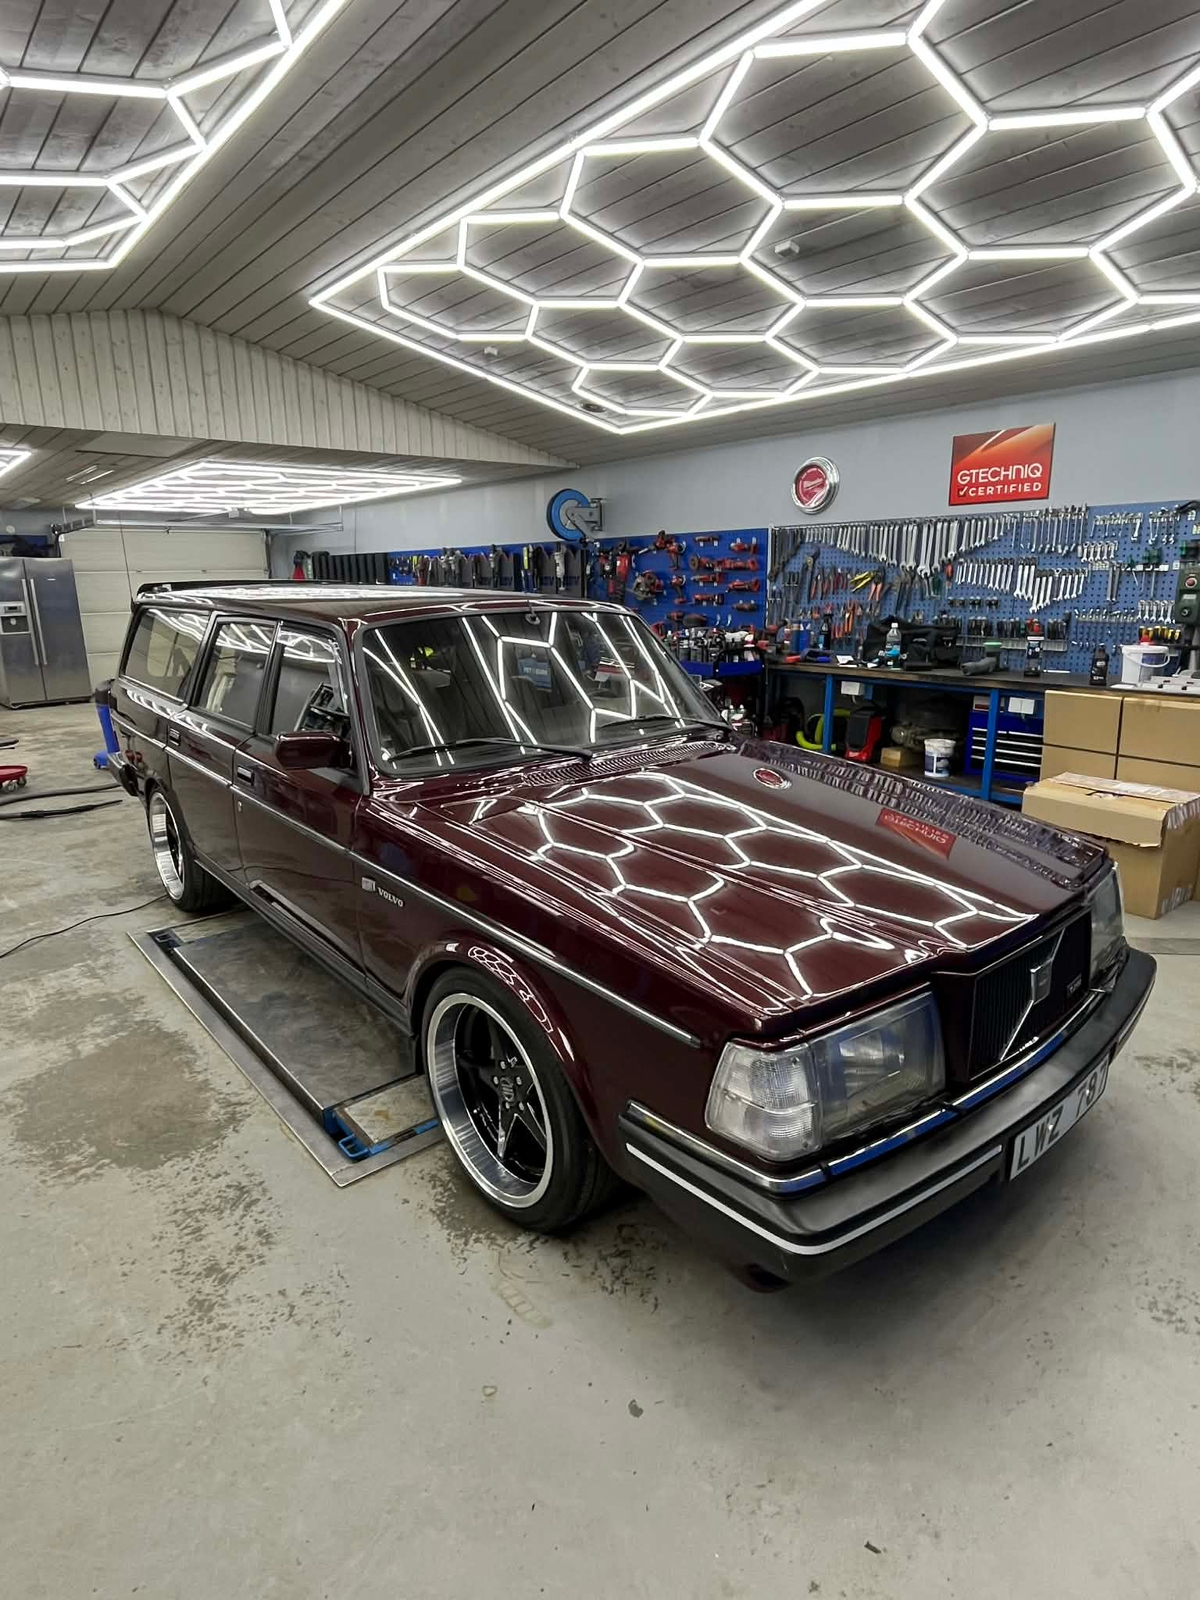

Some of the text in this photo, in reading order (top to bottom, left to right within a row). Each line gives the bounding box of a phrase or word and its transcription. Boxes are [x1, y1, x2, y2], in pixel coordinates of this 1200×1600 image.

[957, 463, 1043, 484] GTECHNIQ
[968, 482, 1042, 497] CERTIFIED
[377, 887, 404, 907] VOLVO
[1017, 1104, 1064, 1171] LWZ
